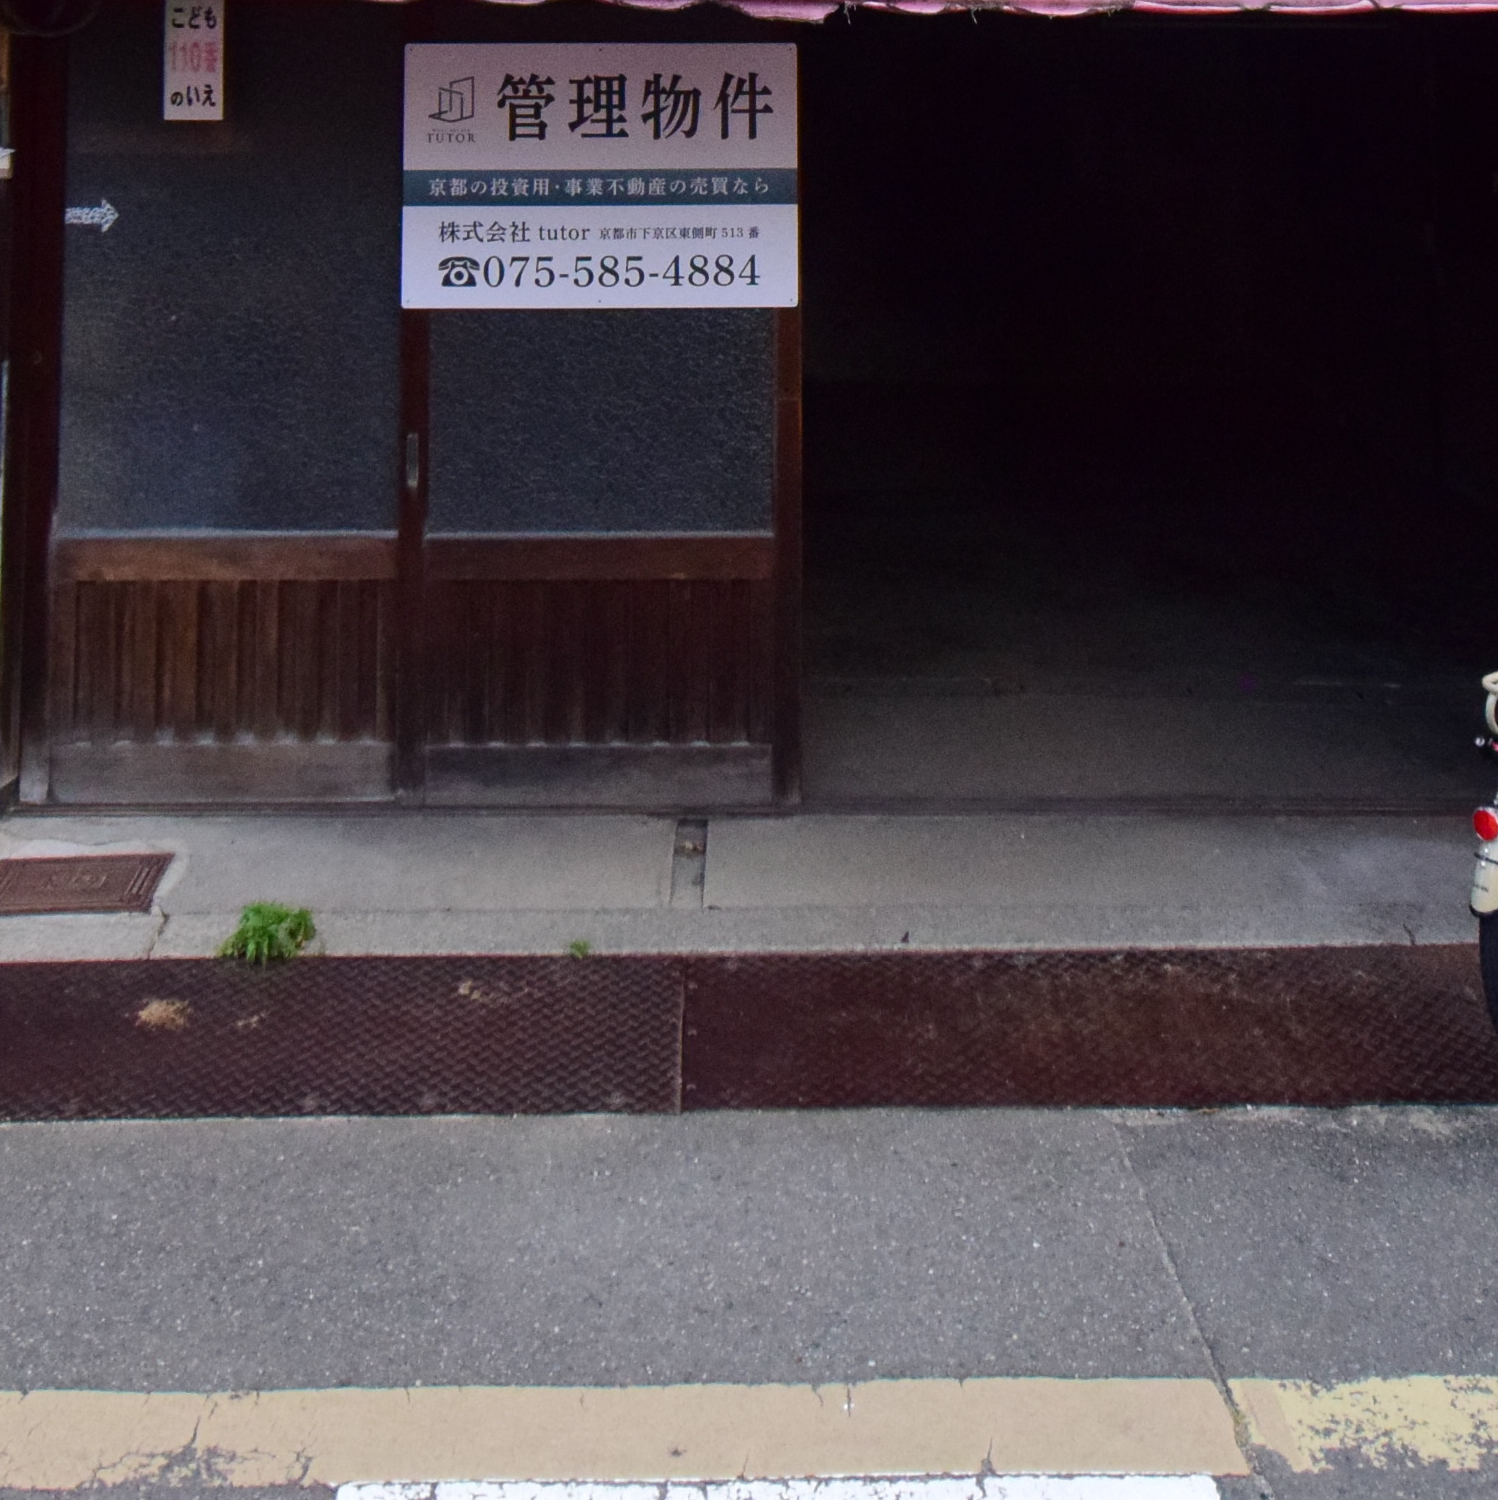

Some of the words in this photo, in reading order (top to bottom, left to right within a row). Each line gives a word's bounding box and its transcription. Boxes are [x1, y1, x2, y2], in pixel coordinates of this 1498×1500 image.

[171, 6, 218, 30] こども
[170, 40, 218, 74] 110番
[169, 83, 217, 107] のいえ
[496, 72, 774, 142] 管理物件
[427, 132, 476, 144] TUTOR
[438, 220, 531, 243] 株式会社
[538, 225, 591, 241] tutor
[598, 226, 717, 240] 京都市下京区東側町
[721, 227, 744, 238] 513
[747, 225, 760, 239] 番
[482, 254, 761, 288] 075-585-4884
